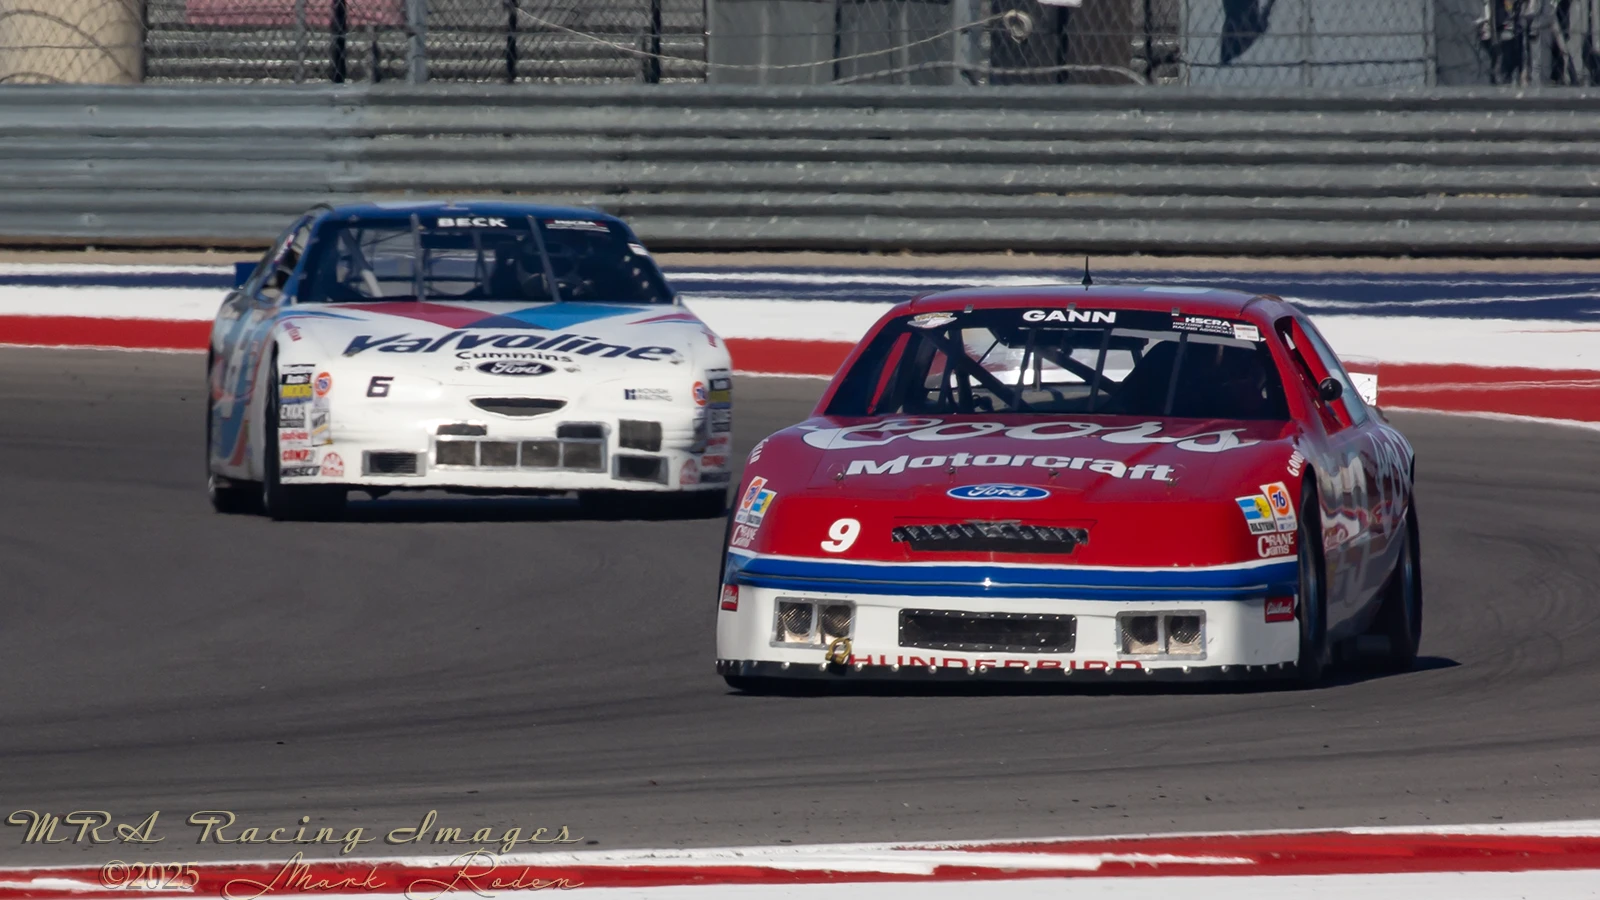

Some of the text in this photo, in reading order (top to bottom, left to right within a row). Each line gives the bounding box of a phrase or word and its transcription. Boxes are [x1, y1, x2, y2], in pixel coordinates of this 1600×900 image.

[437, 217, 508, 228] BECK
[1022, 309, 1117, 324] GANN
[1185, 317, 1231, 327] HSCRA
[342, 330, 677, 361] Valvoline
[455, 350, 574, 363] Cummins
[491, 361, 542, 376] Ford
[366, 376, 395, 397] 6
[797, 418, 1260, 452] Coors
[844, 452, 1176, 481] Motorcraft
[975, 485, 1029, 499] Ford
[1272, 491, 1287, 508] 76
[820, 518, 861, 553] 9
